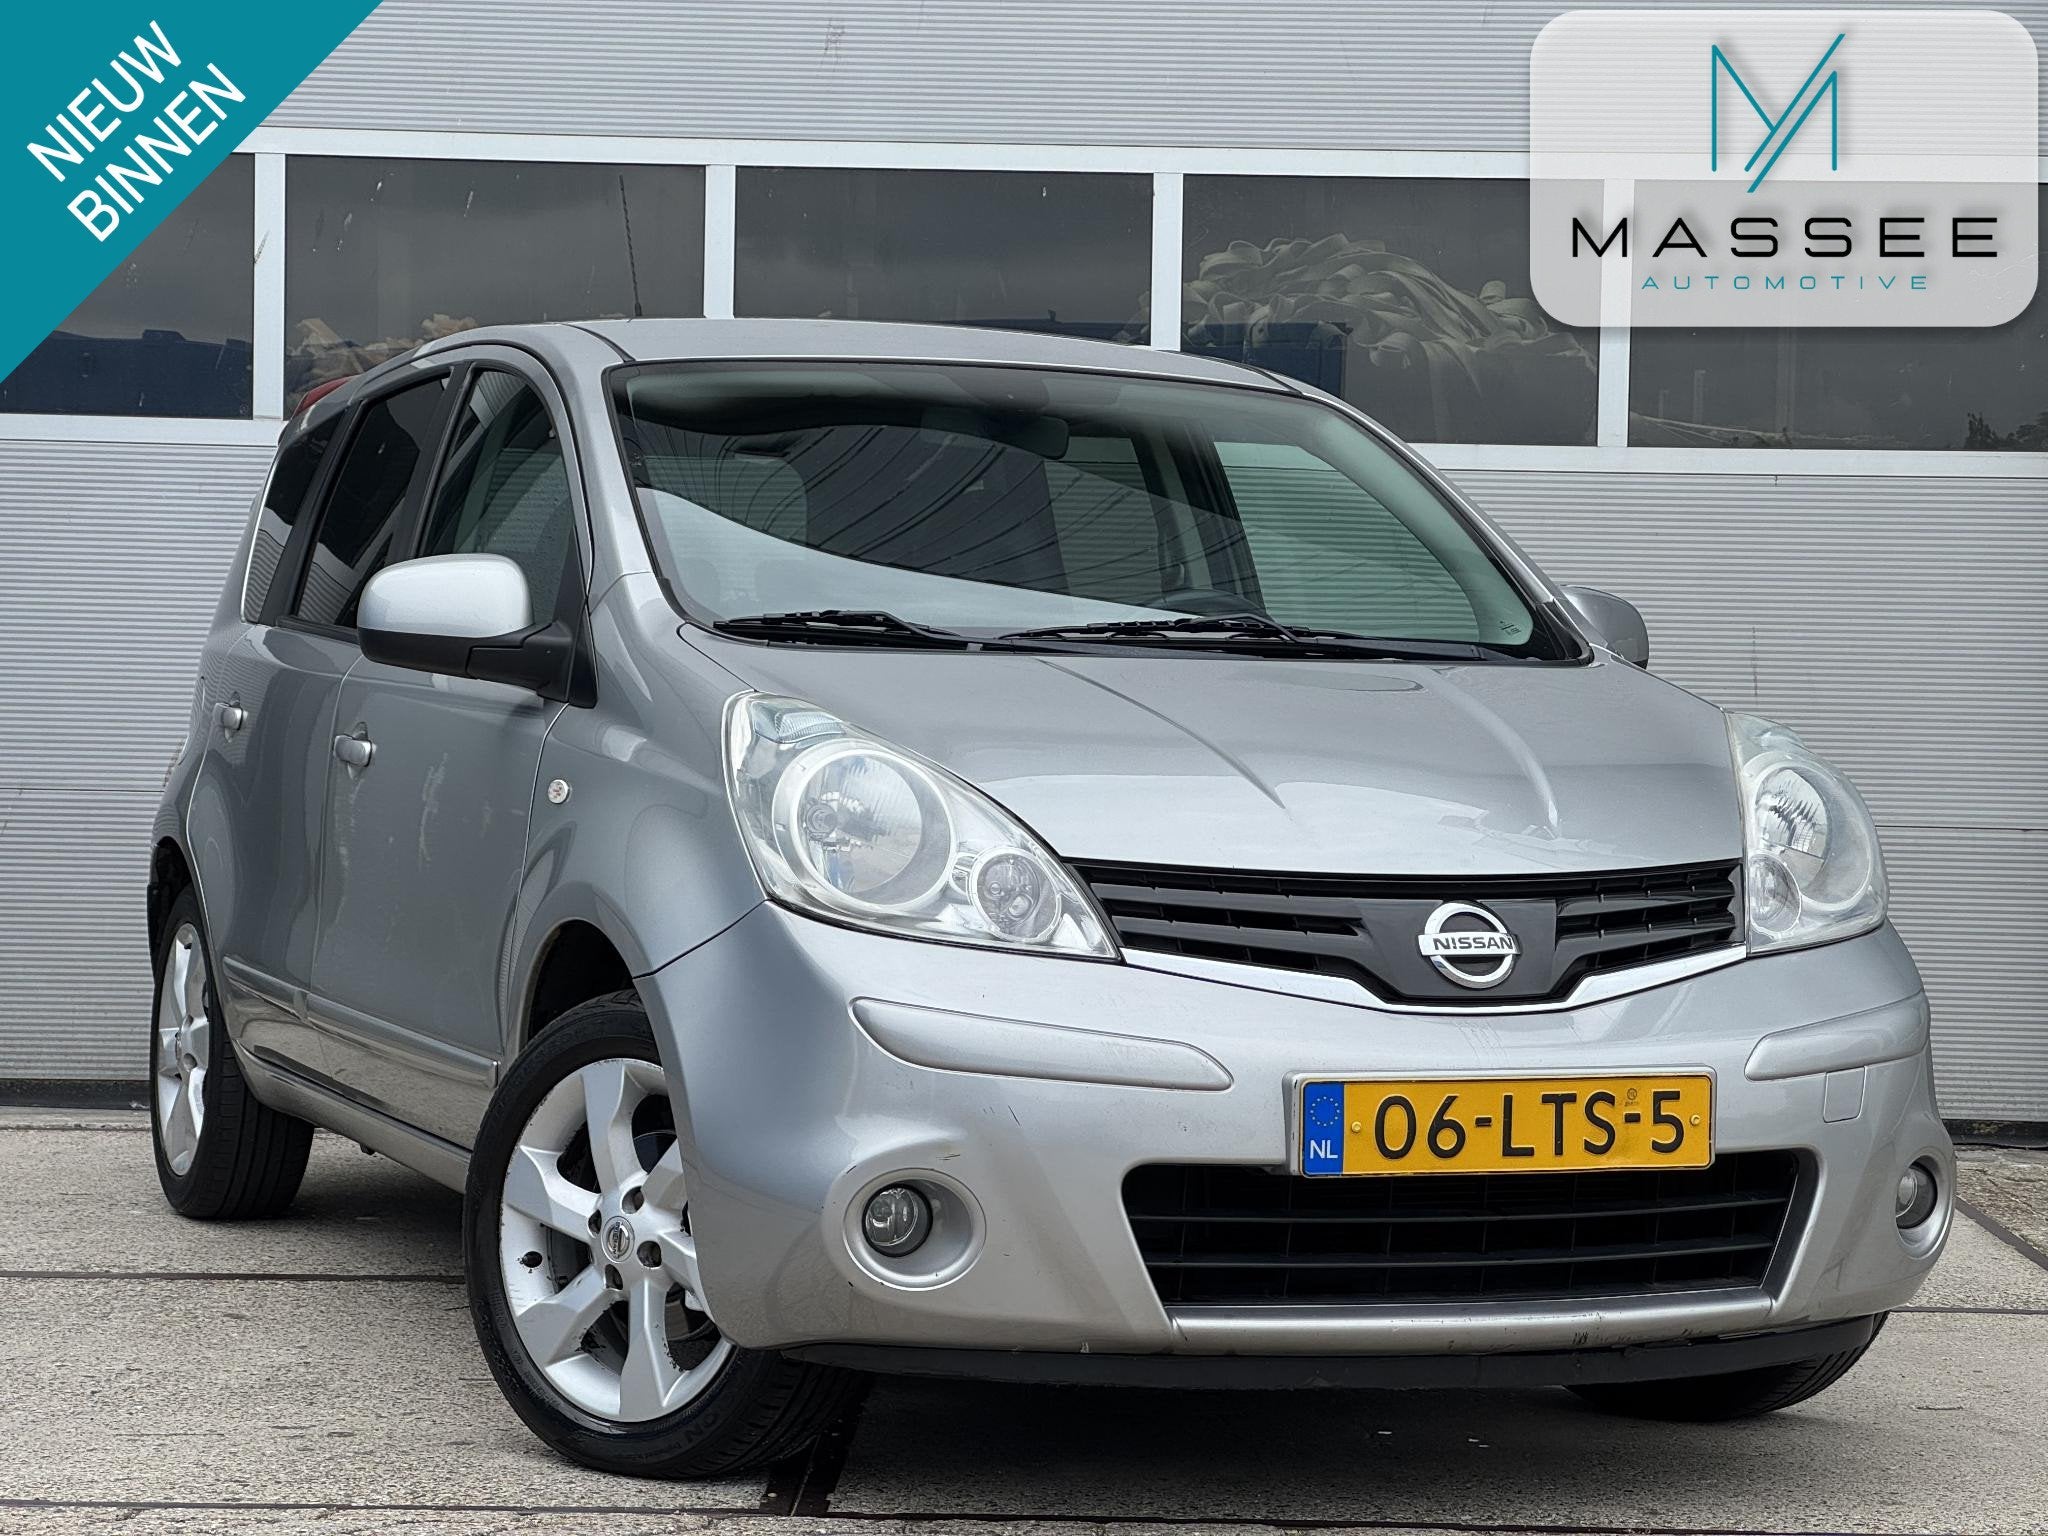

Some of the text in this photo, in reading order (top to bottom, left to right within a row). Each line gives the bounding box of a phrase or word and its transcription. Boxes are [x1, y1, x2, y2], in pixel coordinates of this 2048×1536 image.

[1432, 936, 1514, 951] NISSAN
[1374, 1090, 1685, 1160] 06-LTS-5
[1309, 1139, 1338, 1160] NL
